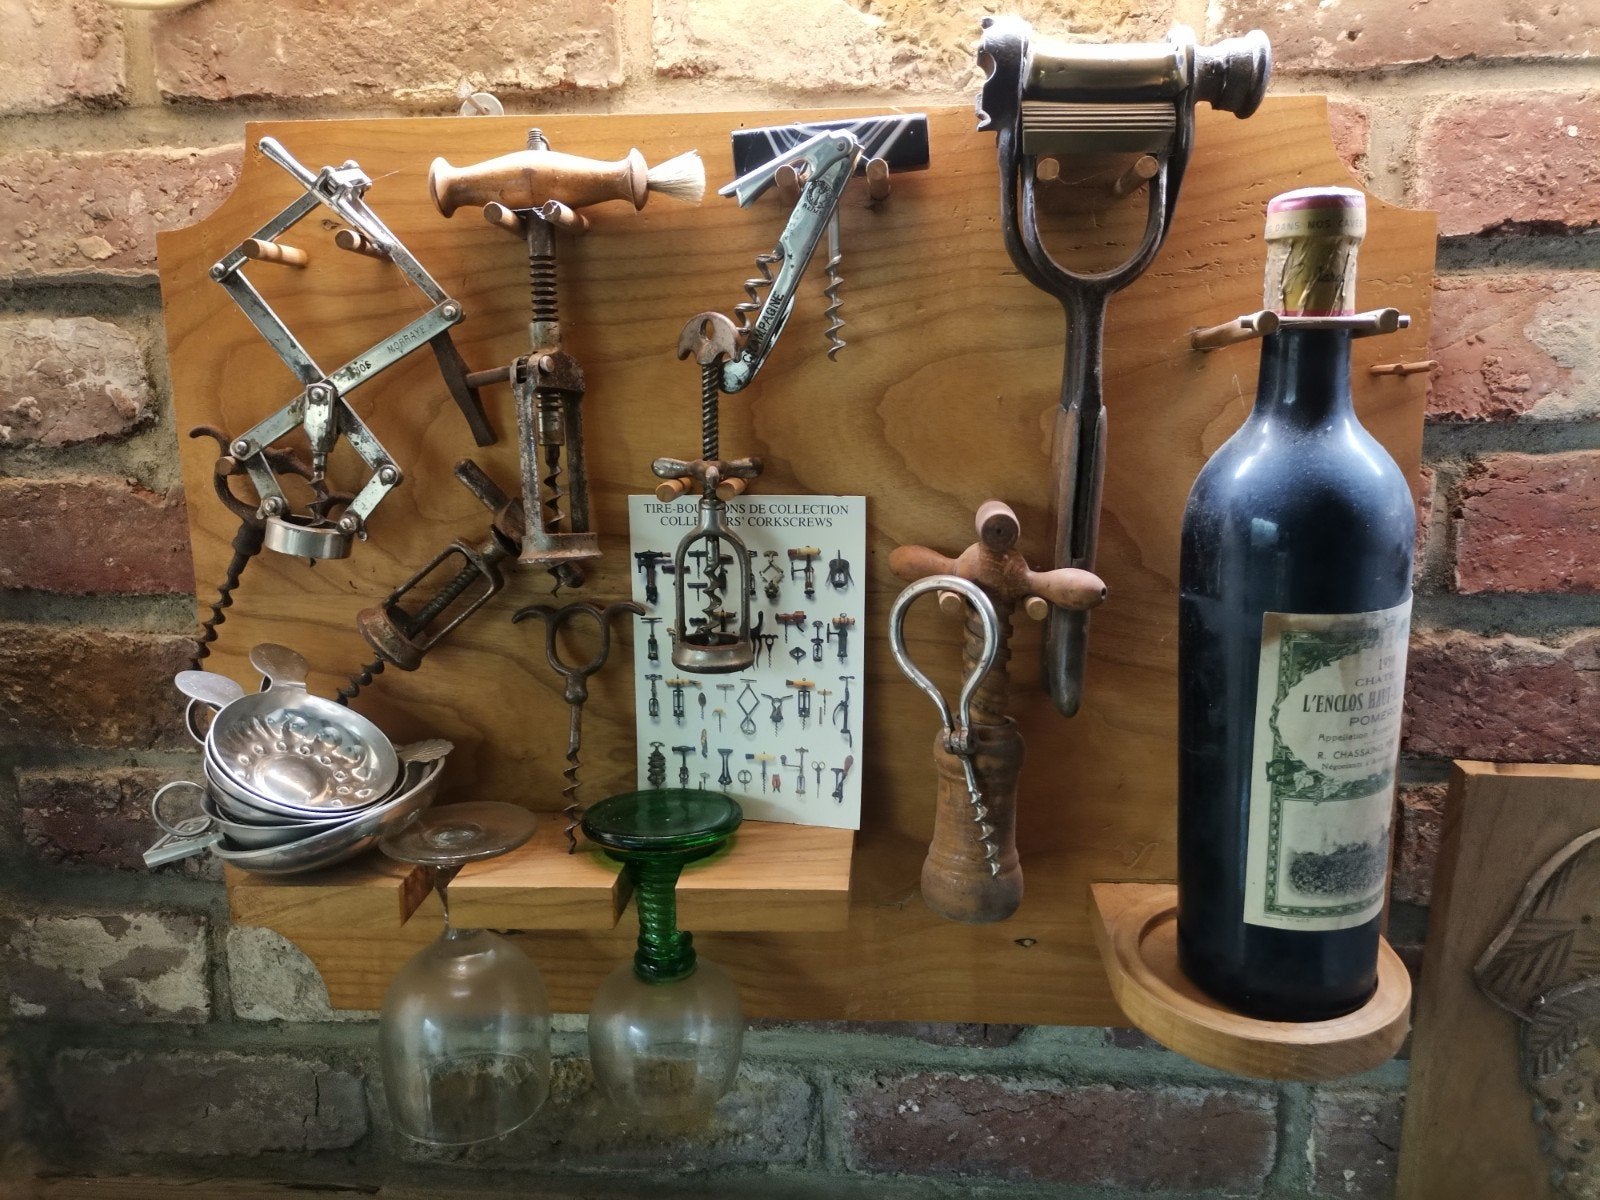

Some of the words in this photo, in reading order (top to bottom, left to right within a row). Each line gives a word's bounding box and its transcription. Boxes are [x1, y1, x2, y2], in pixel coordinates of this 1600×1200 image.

[1307, 220, 1332, 229] NOS
[742, 291, 785, 363] CMPAGNE
[749, 504, 766, 514] DE
[769, 503, 849, 515] COLLECTION
[747, 516, 833, 527] CORKSCREWS
[1303, 692, 1364, 713] L'ENCLOS
